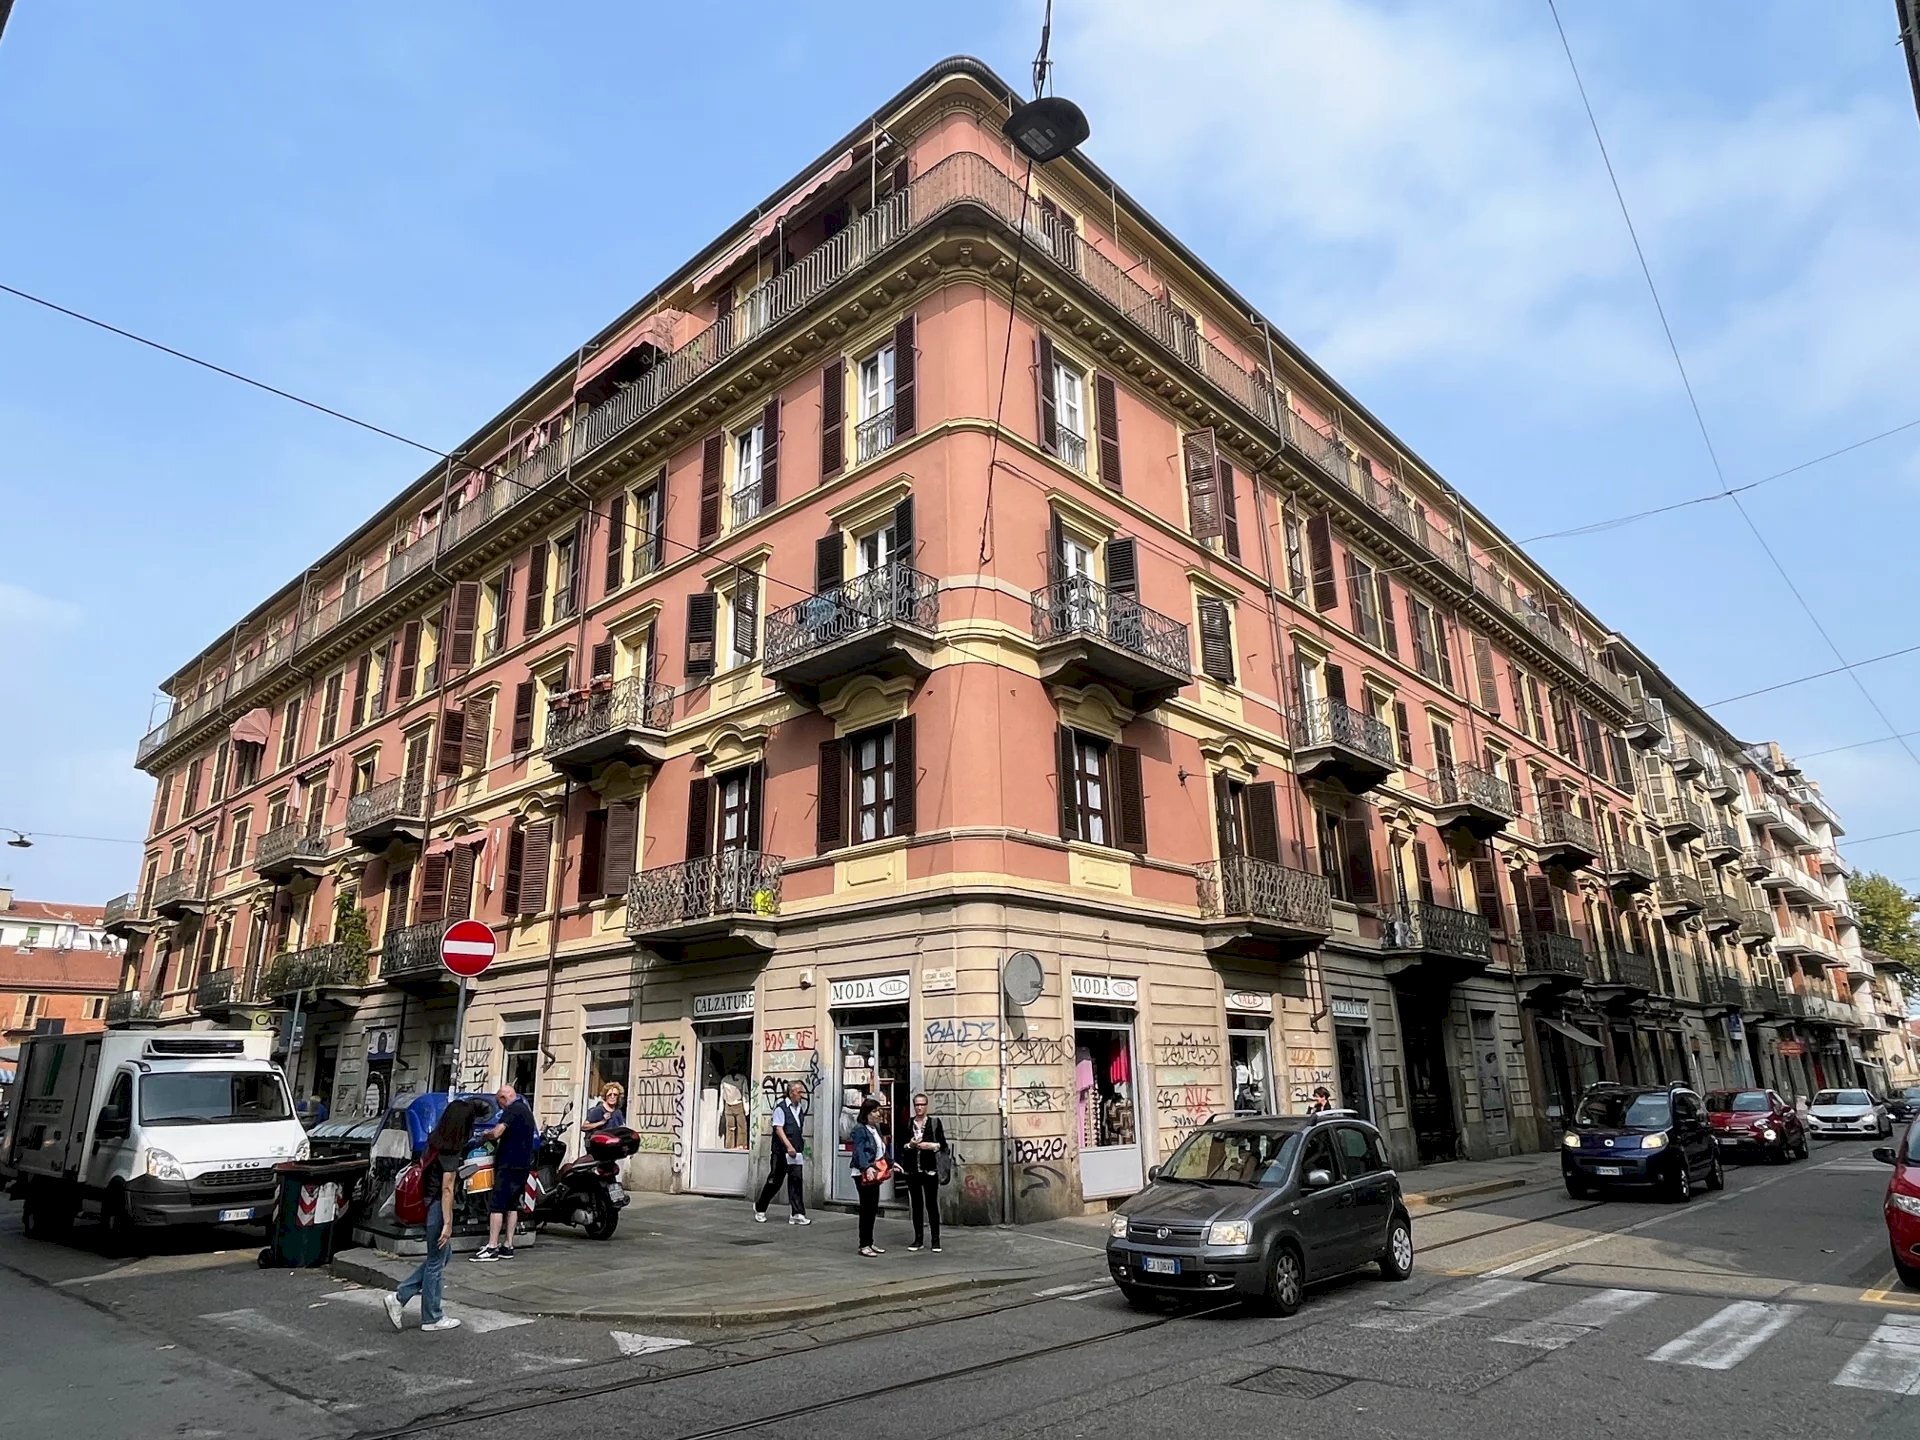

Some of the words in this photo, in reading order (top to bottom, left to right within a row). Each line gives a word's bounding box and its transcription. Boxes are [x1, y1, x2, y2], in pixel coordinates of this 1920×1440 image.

[833, 982, 875, 1001] MODA
[1072, 977, 1110, 996] MODA
[695, 994, 755, 1013] CALZATURE
[1238, 994, 1258, 1005] VALE
[221, 1161, 260, 1170] IVECO
